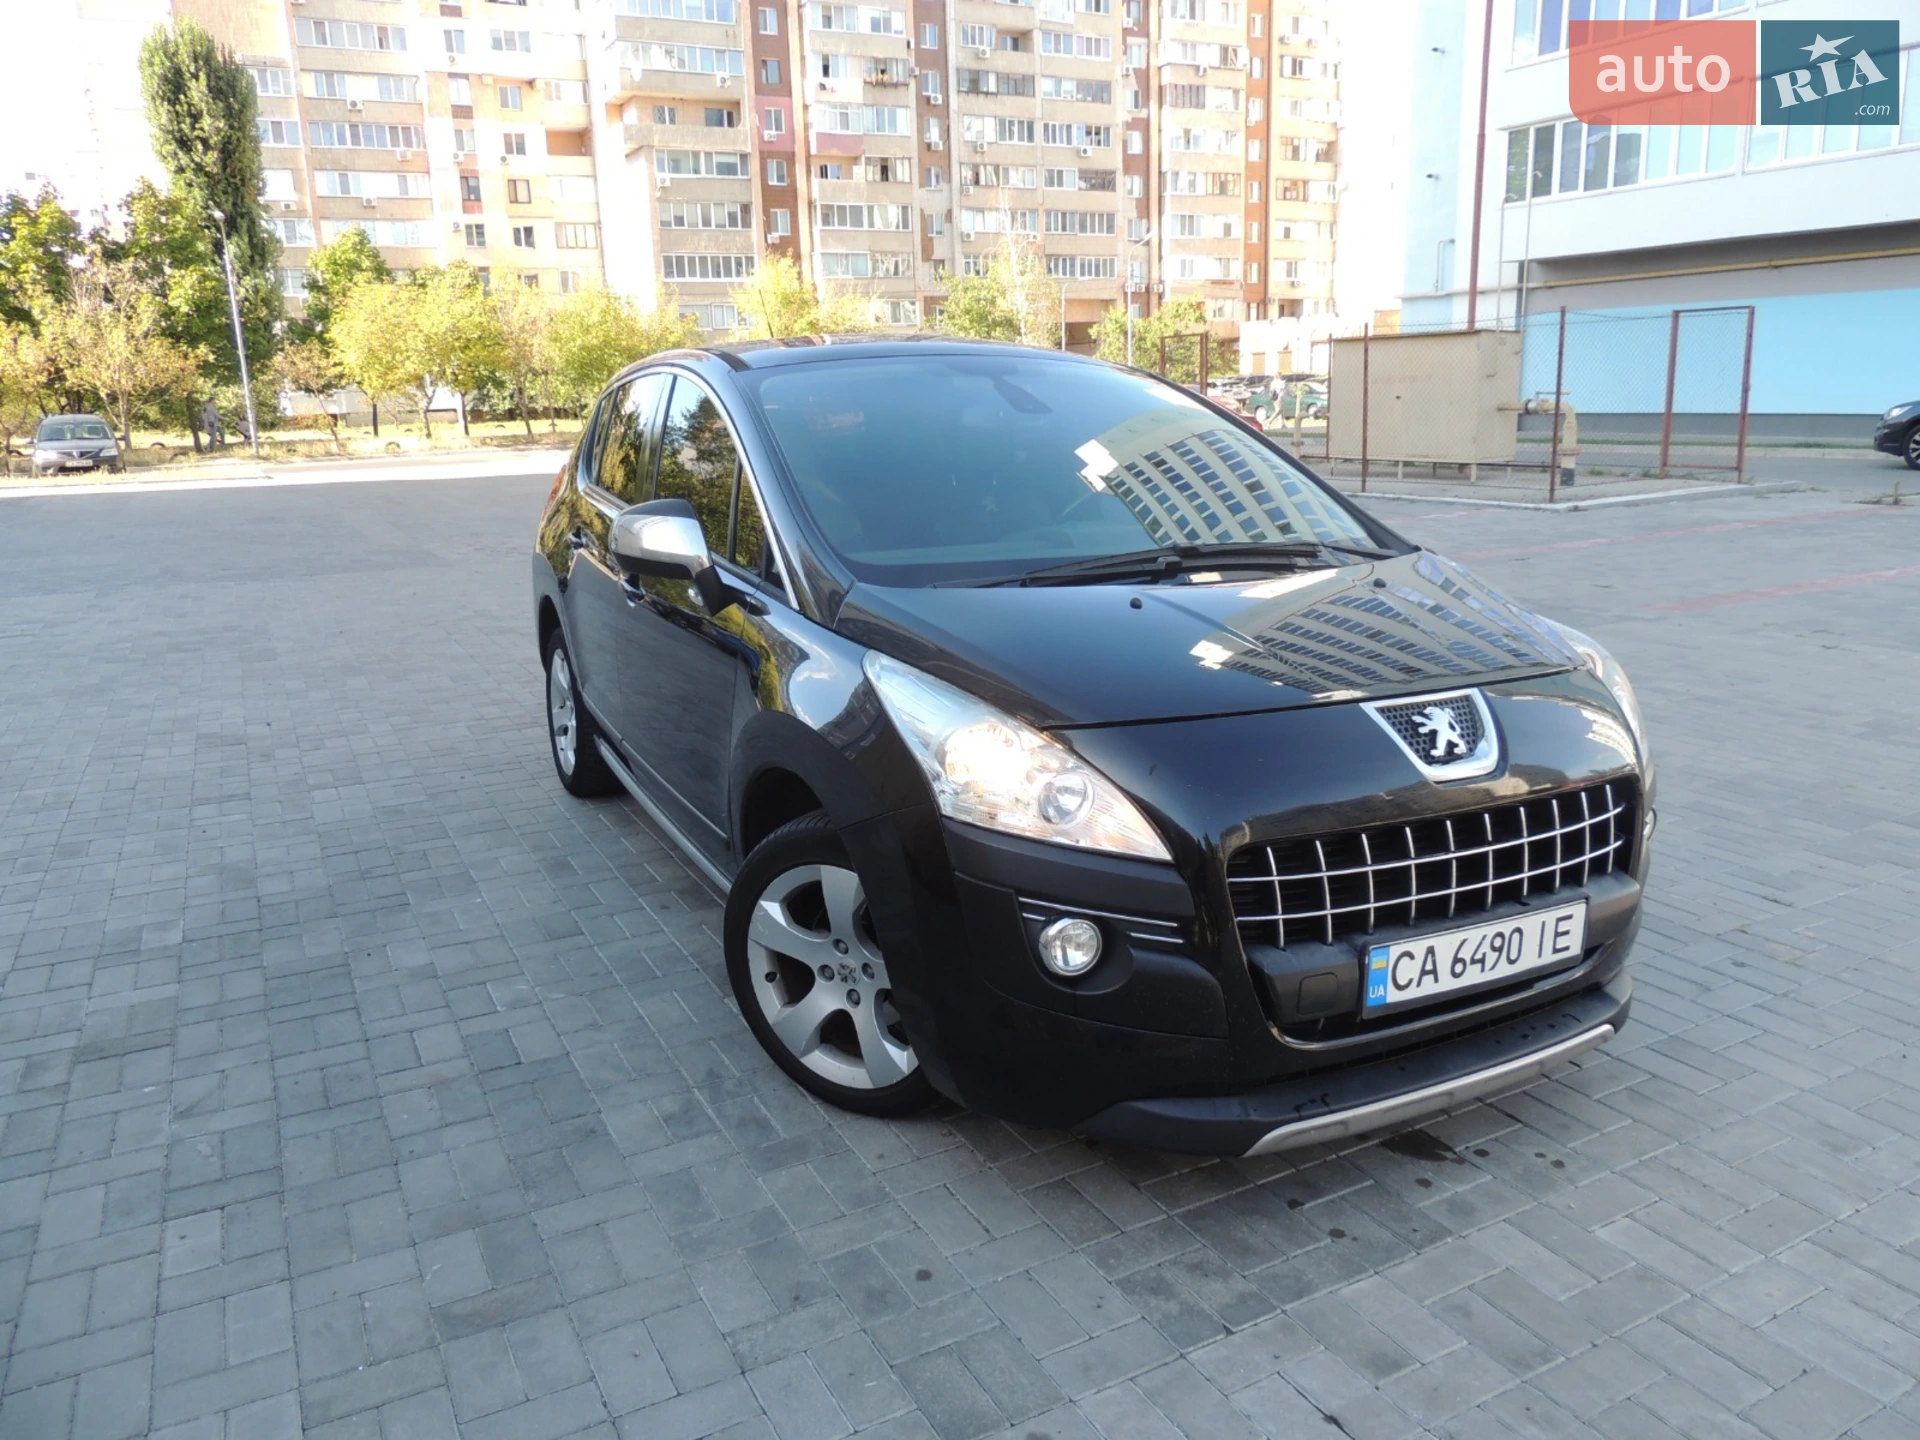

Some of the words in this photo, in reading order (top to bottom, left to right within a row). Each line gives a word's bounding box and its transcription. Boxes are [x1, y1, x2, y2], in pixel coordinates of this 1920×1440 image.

[1390, 944, 1439, 991] CA
[1450, 926, 1524, 979] 6490
[1537, 913, 1574, 959] IE
[1369, 985, 1385, 999] UA
